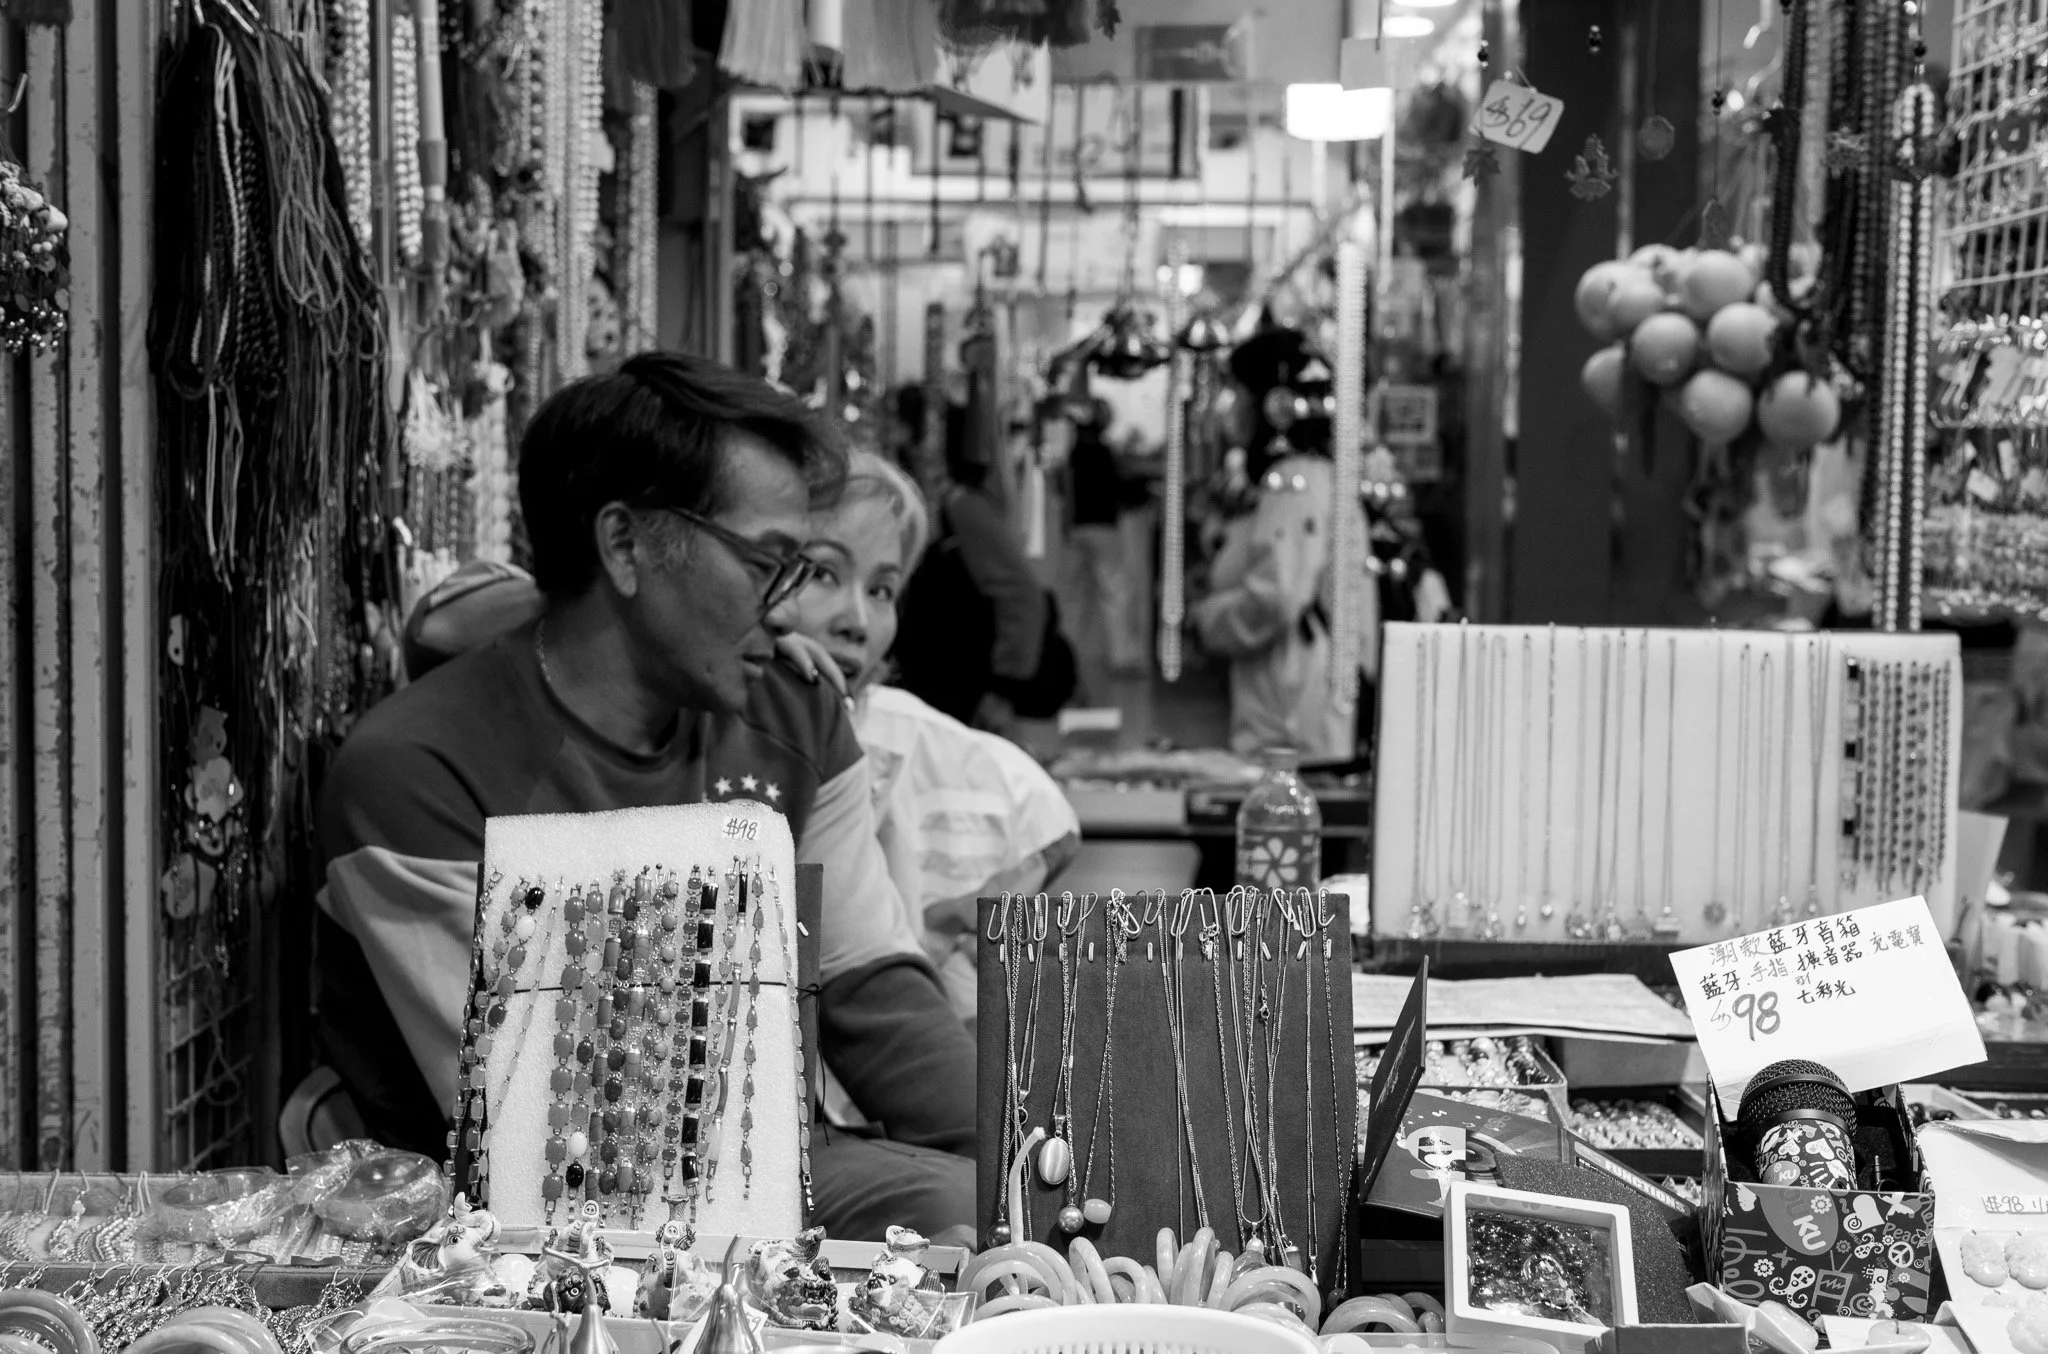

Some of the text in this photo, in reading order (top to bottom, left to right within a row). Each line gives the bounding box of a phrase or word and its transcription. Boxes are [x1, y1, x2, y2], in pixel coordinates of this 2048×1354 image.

[1482, 95, 1552, 149] $69
[723, 818, 758, 840] $98
[1986, 1194, 2025, 1213] $98
[1882, 1222, 1926, 1247] Peac
